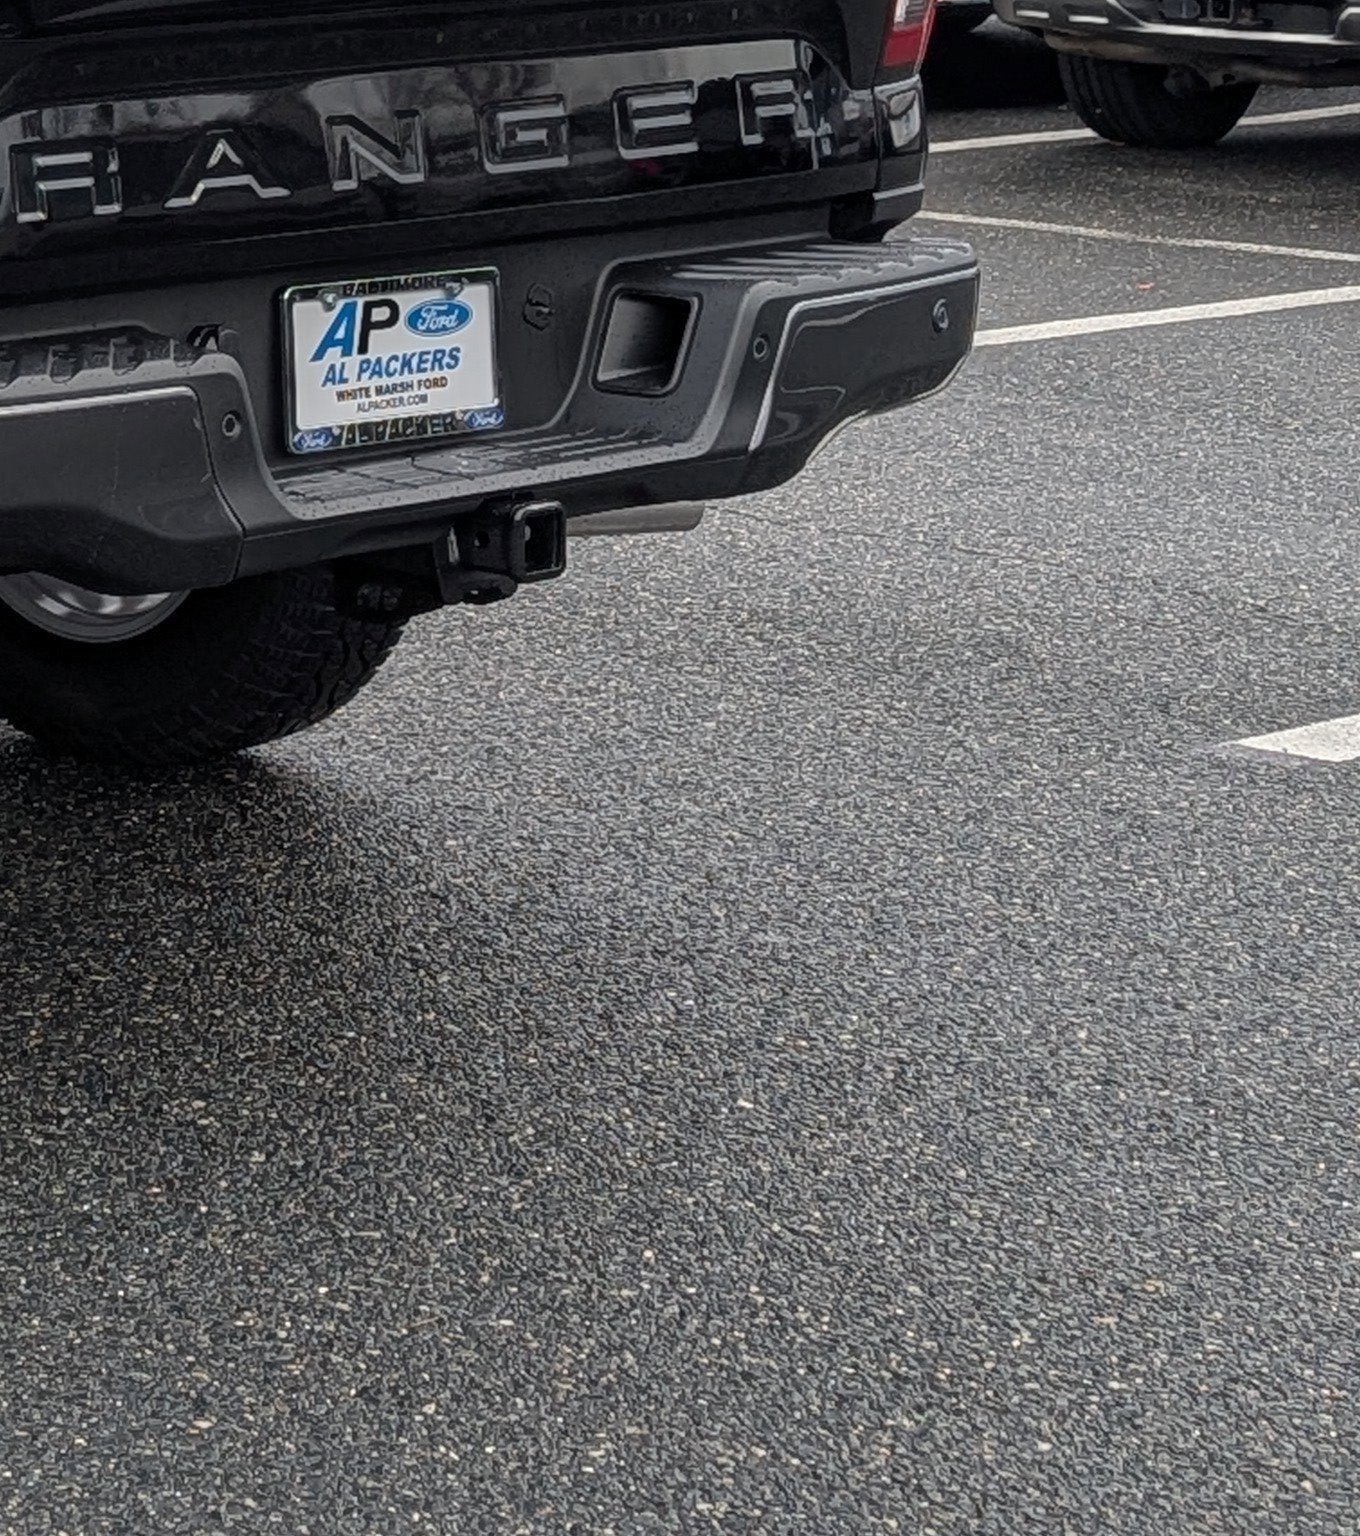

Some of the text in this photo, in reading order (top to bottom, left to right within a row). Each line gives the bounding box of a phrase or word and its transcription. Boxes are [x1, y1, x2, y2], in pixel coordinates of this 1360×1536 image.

[8, 72, 820, 224] RANGER
[342, 275, 447, 297] BALTIMORE
[308, 298, 461, 363] AP Ford
[321, 346, 462, 388] AL PACKERS
[335, 375, 449, 402] WHITE MARSH FORD
[356, 394, 429, 413] ALPACKER.COM
[341, 413, 457, 447] AL PACKER
